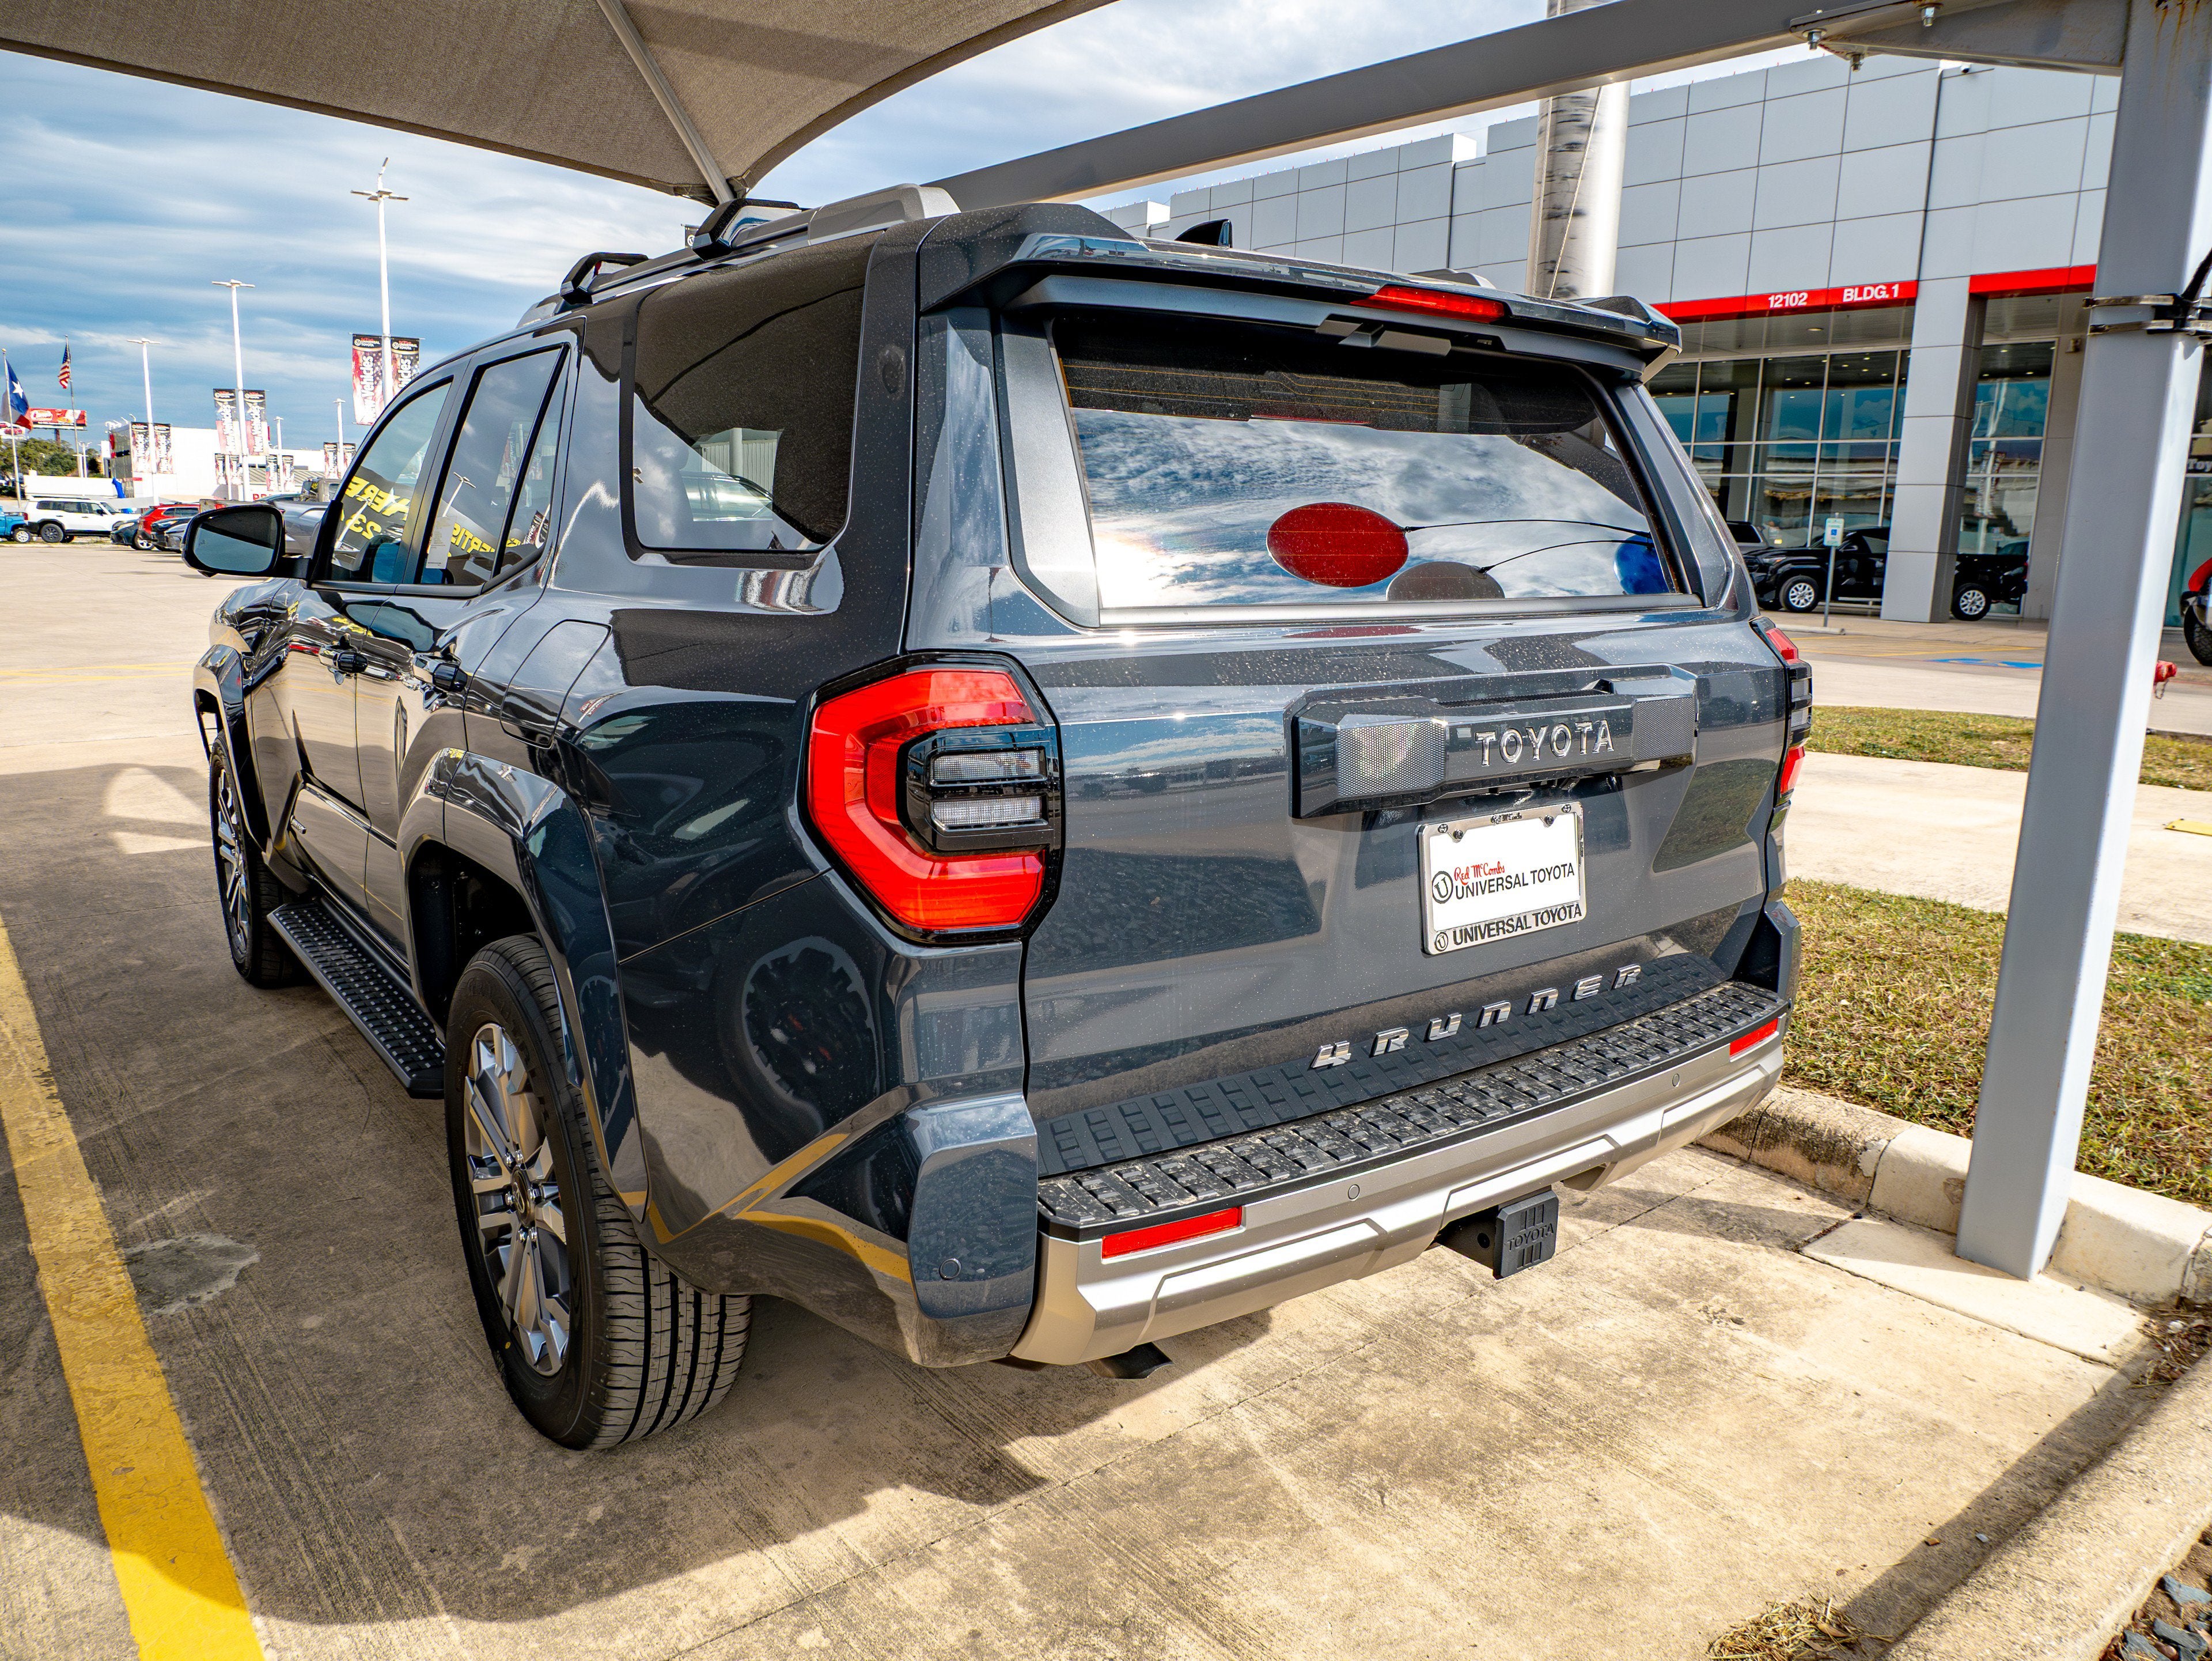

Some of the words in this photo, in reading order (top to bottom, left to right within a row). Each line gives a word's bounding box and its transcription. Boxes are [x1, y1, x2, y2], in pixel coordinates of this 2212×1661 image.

[1768, 292, 1808, 308] 12102
[1843, 285, 1889, 302] BLDG.
[1892, 283, 1899, 298] 1
[359, 355, 374, 397] Vehicles
[397, 358, 412, 388] hicles
[1475, 719, 1615, 767] TOYOTA
[1454, 867, 1469, 886] Red
[1471, 861, 1505, 879] McCombs
[1456, 872, 1529, 900] UNIVERSAL
[1531, 862, 1575, 884] TOYOTA
[1453, 914, 1532, 945] UNIVERSAL
[1532, 903, 1582, 927] TOYOTA
[1508, 1223, 1554, 1252] TOYOTA
